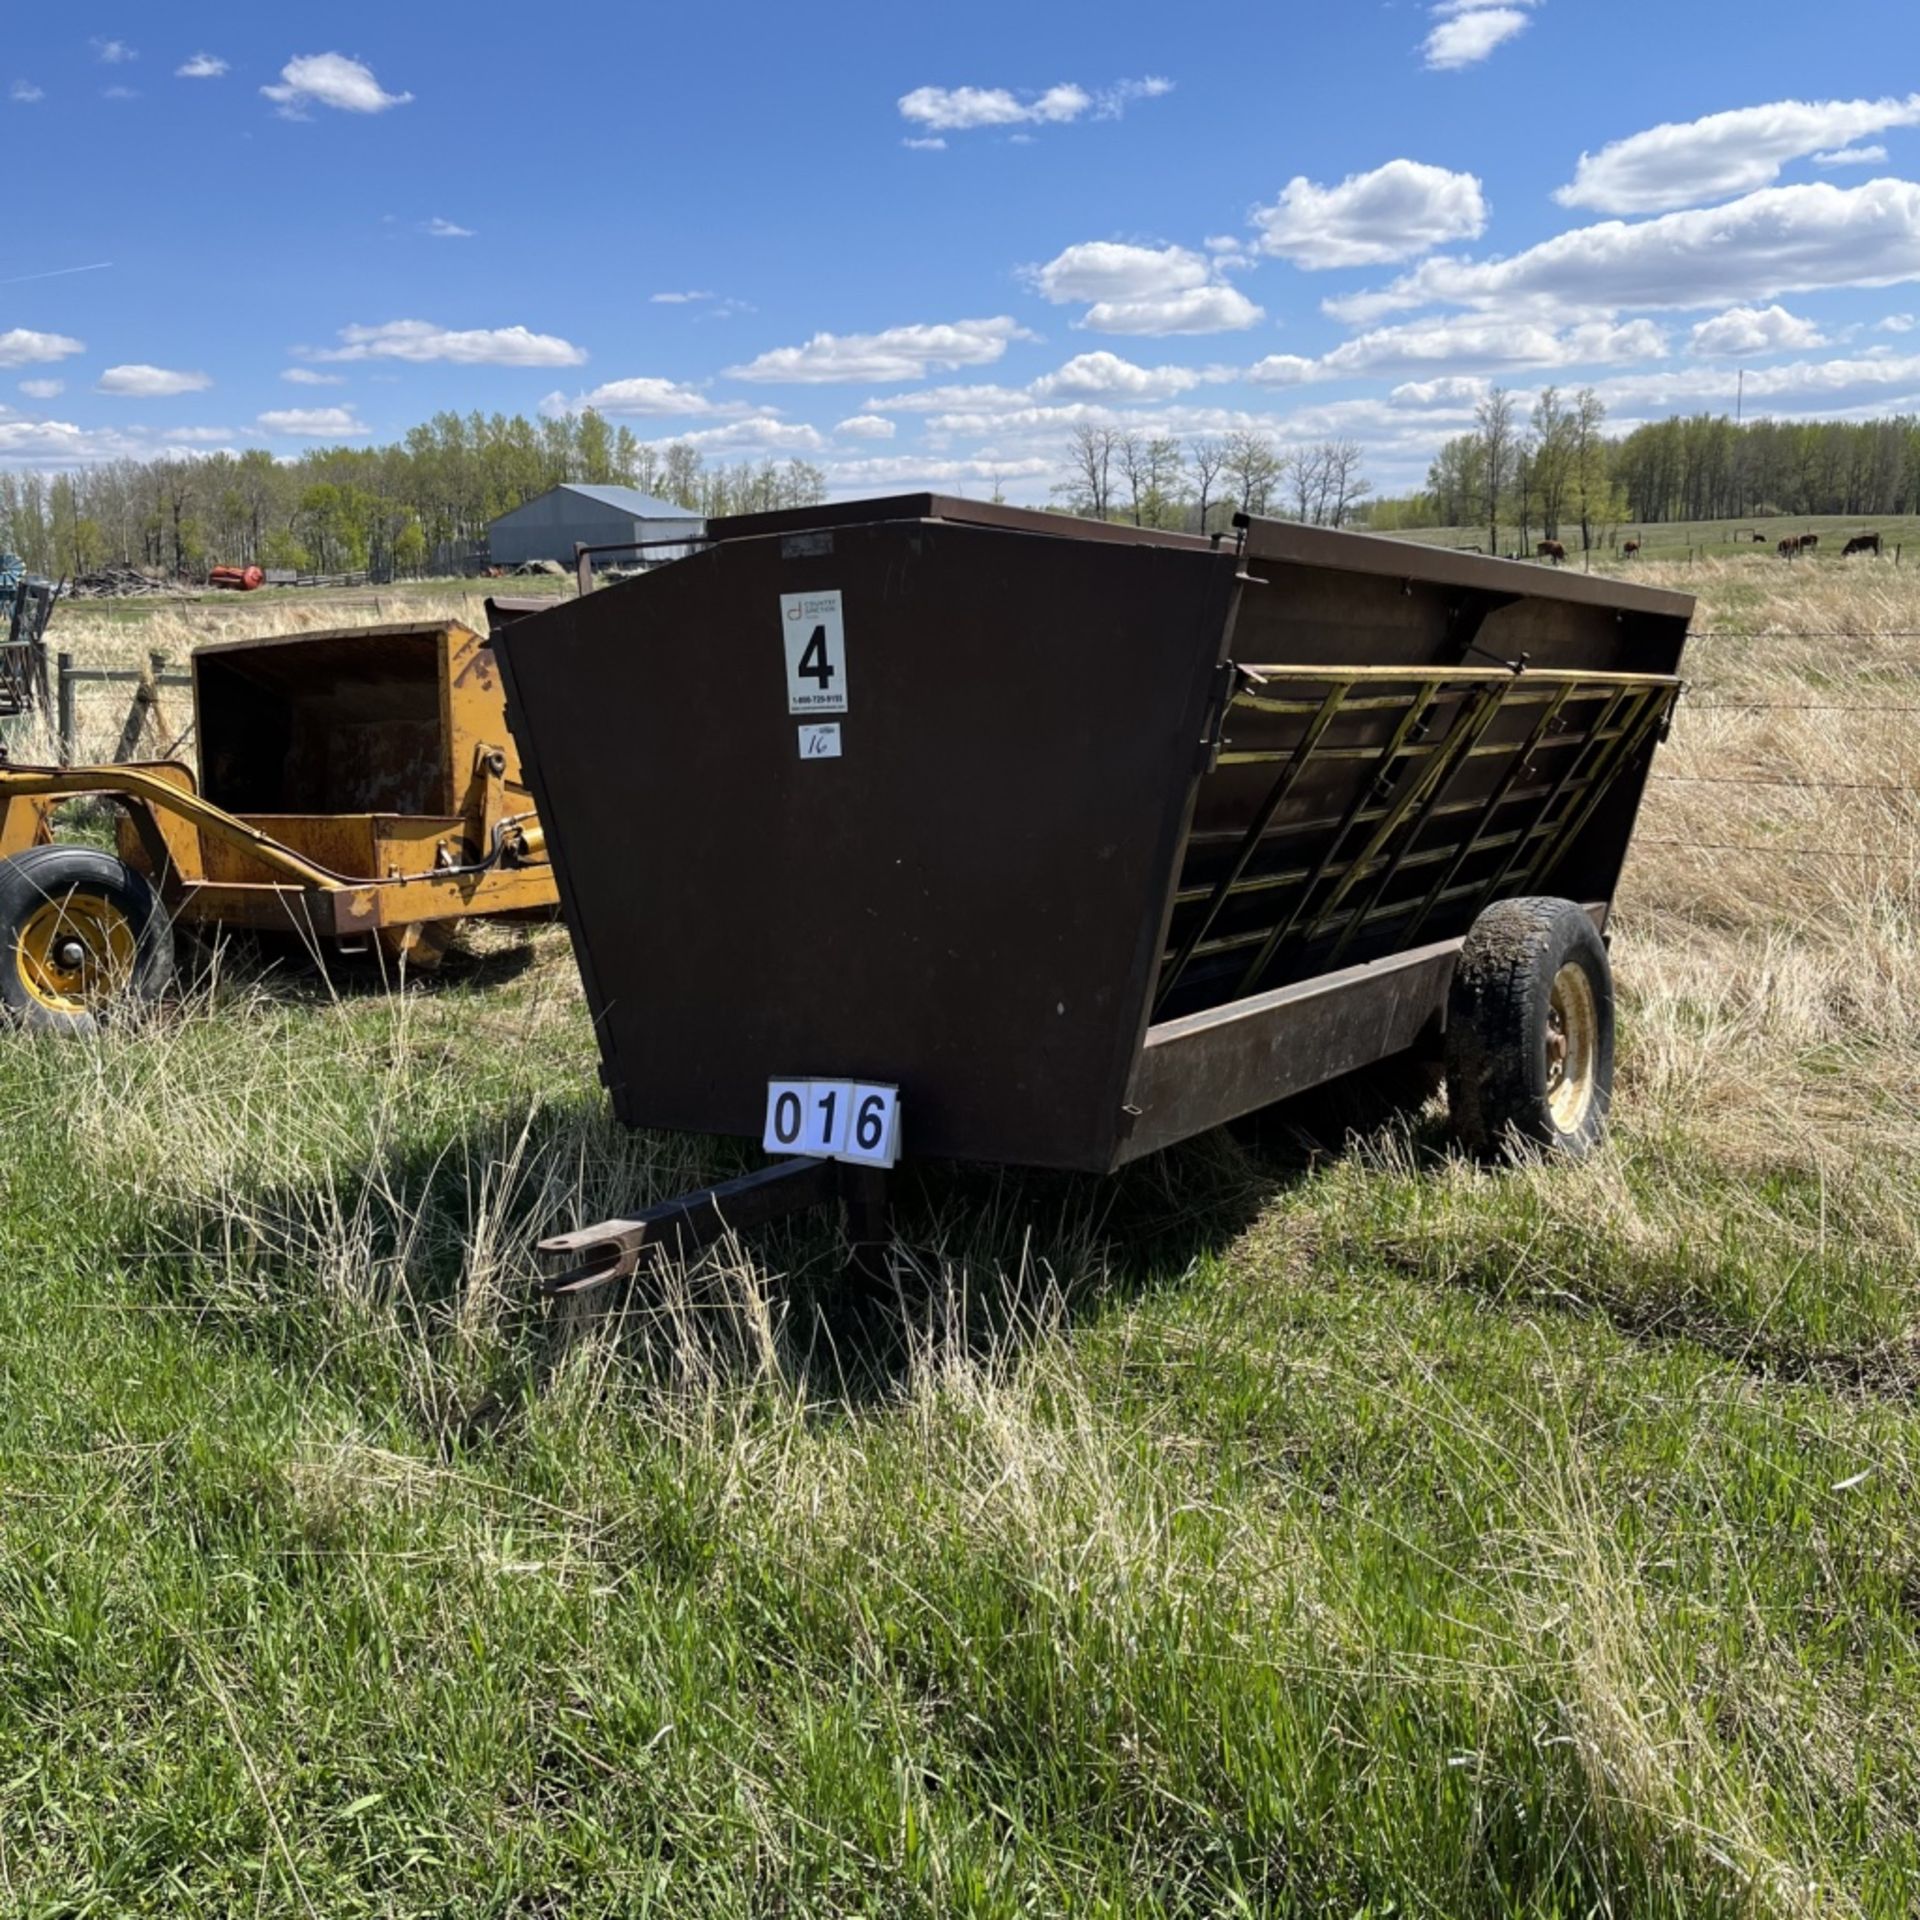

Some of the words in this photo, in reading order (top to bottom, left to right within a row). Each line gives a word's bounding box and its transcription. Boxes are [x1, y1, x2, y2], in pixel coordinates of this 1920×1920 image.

[798, 624, 835, 690] 4
[808, 734, 828, 755] 16
[774, 1091, 886, 1150] 016
